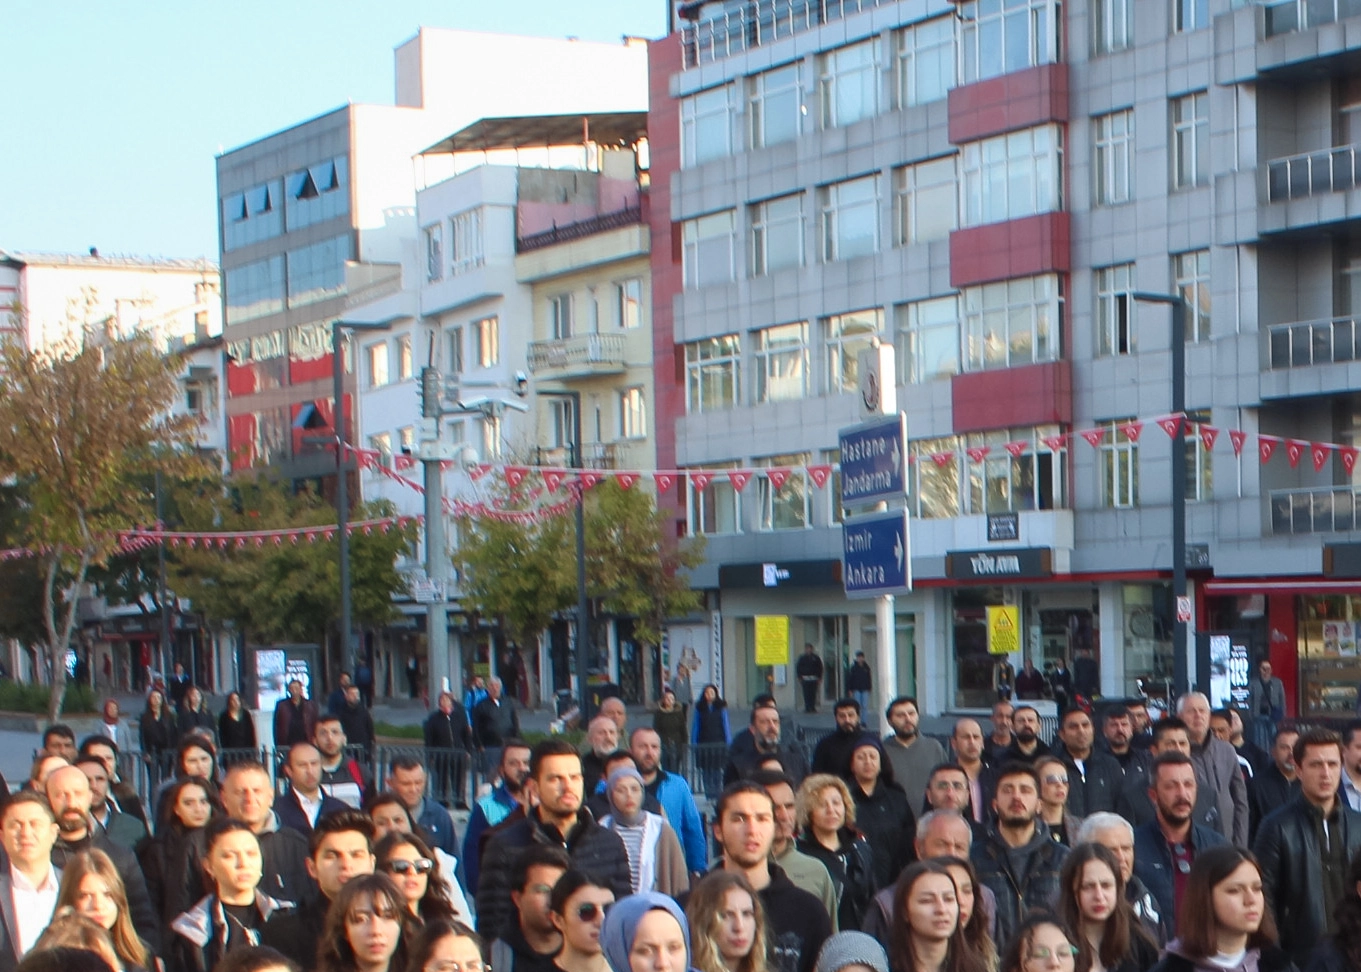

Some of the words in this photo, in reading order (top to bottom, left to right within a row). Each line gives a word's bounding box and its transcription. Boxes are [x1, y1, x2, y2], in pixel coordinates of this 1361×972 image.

[841, 437, 886, 464] Hastane
[843, 469, 892, 497] Jandarma
[846, 562, 886, 588] Ankara
